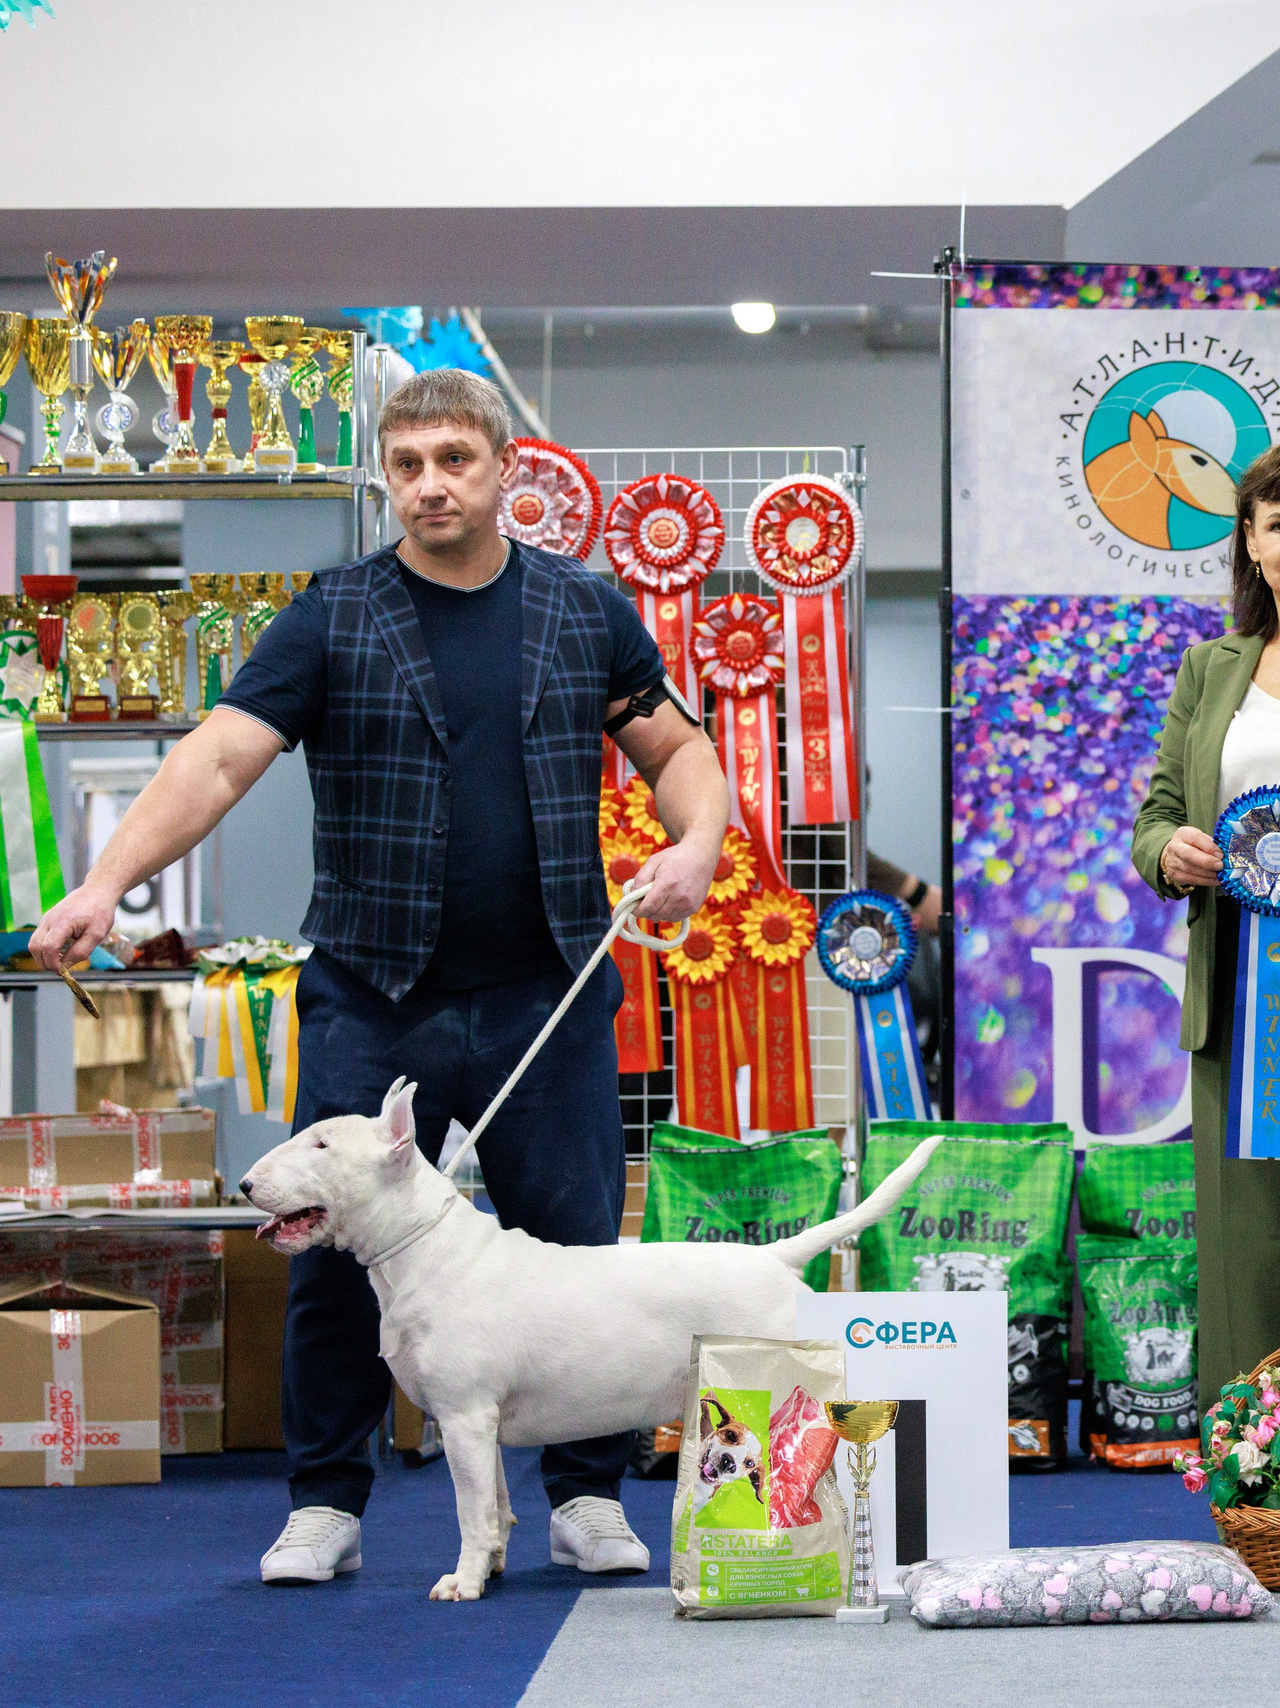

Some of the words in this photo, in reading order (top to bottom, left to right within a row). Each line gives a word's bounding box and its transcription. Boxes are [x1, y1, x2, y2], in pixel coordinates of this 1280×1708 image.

[1055, 454, 1230, 579] КИНОЛОГИЧЕСК
[808, 737, 827, 761] 3
[685, 1214, 809, 1246] ZooRing
[899, 1206, 1030, 1248] ZooRing
[1126, 1208, 1196, 1240] ZooR
[845, 1317, 958, 1349] СФЕРА
[936, 1343, 958, 1351] ЦЕНТР
[1134, 1393, 1160, 1407] DOG
[1161, 1390, 1192, 1407] FOOD
[889, 1399, 927, 1566] 1
[761, 1579, 786, 1587] ПОРОД
[783, 1571, 804, 1579] СОБАК
[729, 1591, 736, 1600] С
[737, 1589, 786, 1600] ЯГНЕНКОМ
